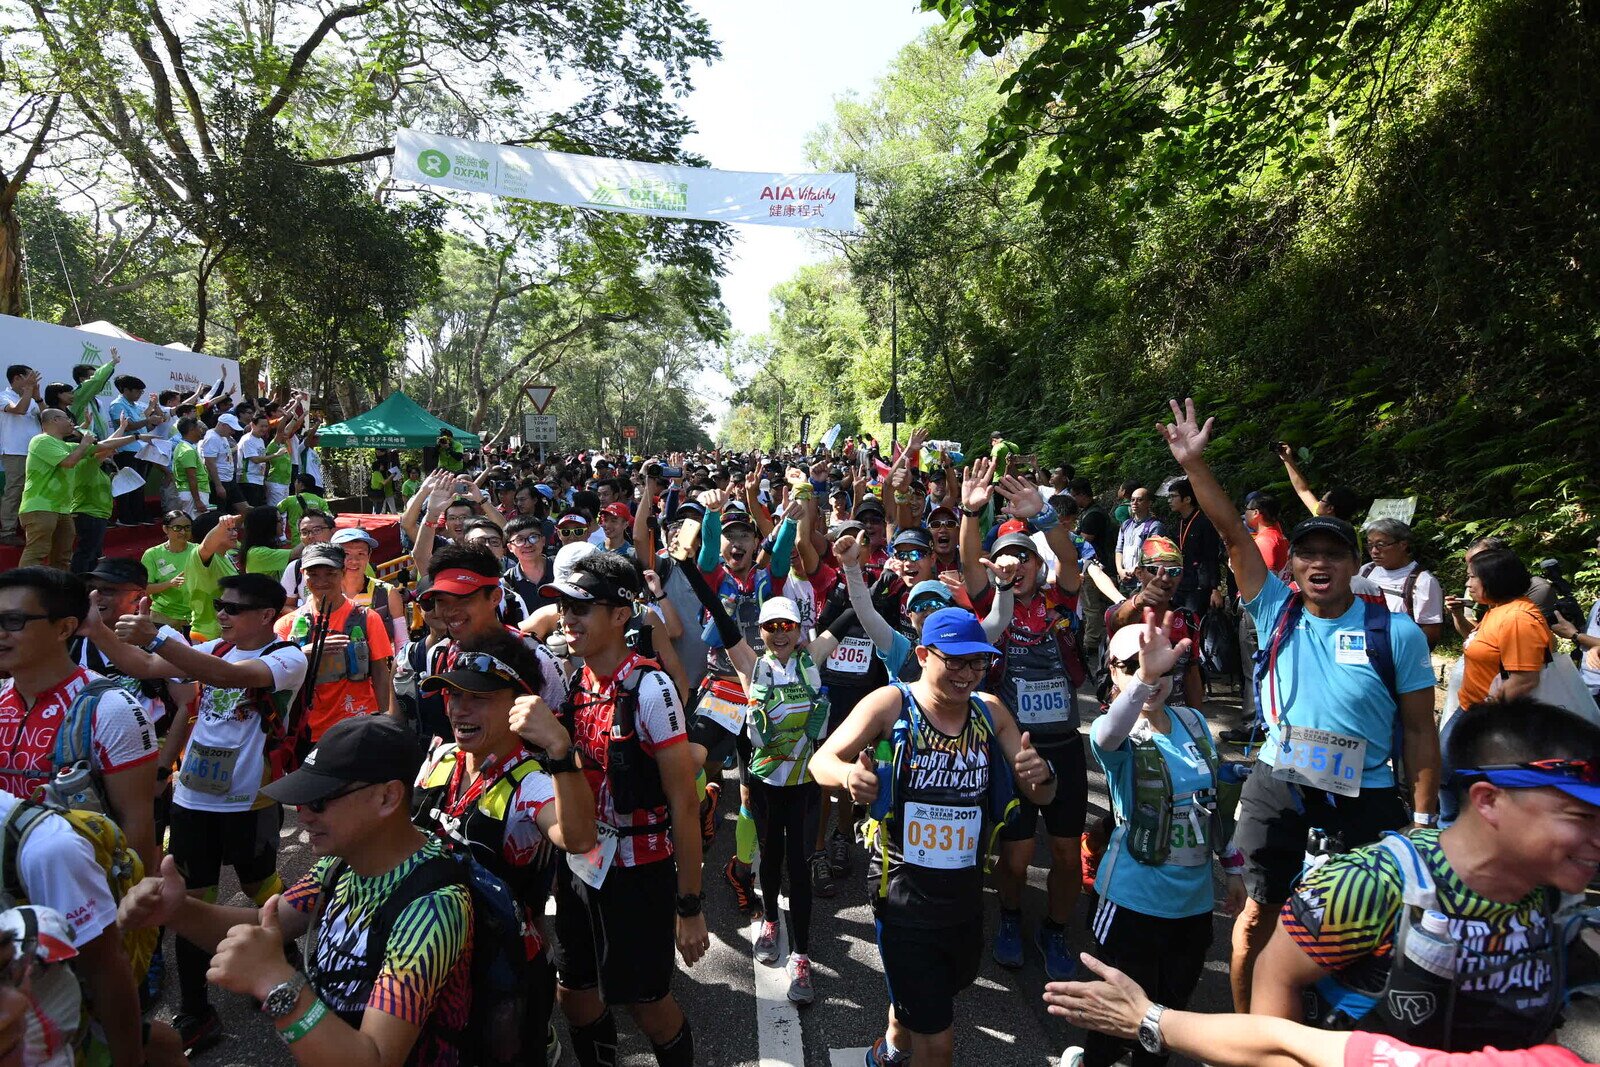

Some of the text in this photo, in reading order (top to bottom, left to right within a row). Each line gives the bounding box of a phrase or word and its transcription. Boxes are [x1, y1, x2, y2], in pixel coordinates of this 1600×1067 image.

[454, 167, 489, 181] OXFAM
[760, 185, 836, 205] AIA Vitality
[769, 204, 825, 218] 健康程式
[170, 371, 184, 381] AIA
[858, 640, 872, 648] 2017
[662, 689, 674, 708] FOOK
[668, 711, 679, 732] TONG
[132, 707, 147, 728] FOOK
[141, 730, 153, 751] TONG
[1303, 732, 1330, 743] OXFAM
[1330, 737, 1360, 751] 2017
[205, 749, 234, 760] 2017
[954, 810, 978, 820] 2017
[908, 820, 975, 852] 0331B
[66, 906, 87, 920] AIA
